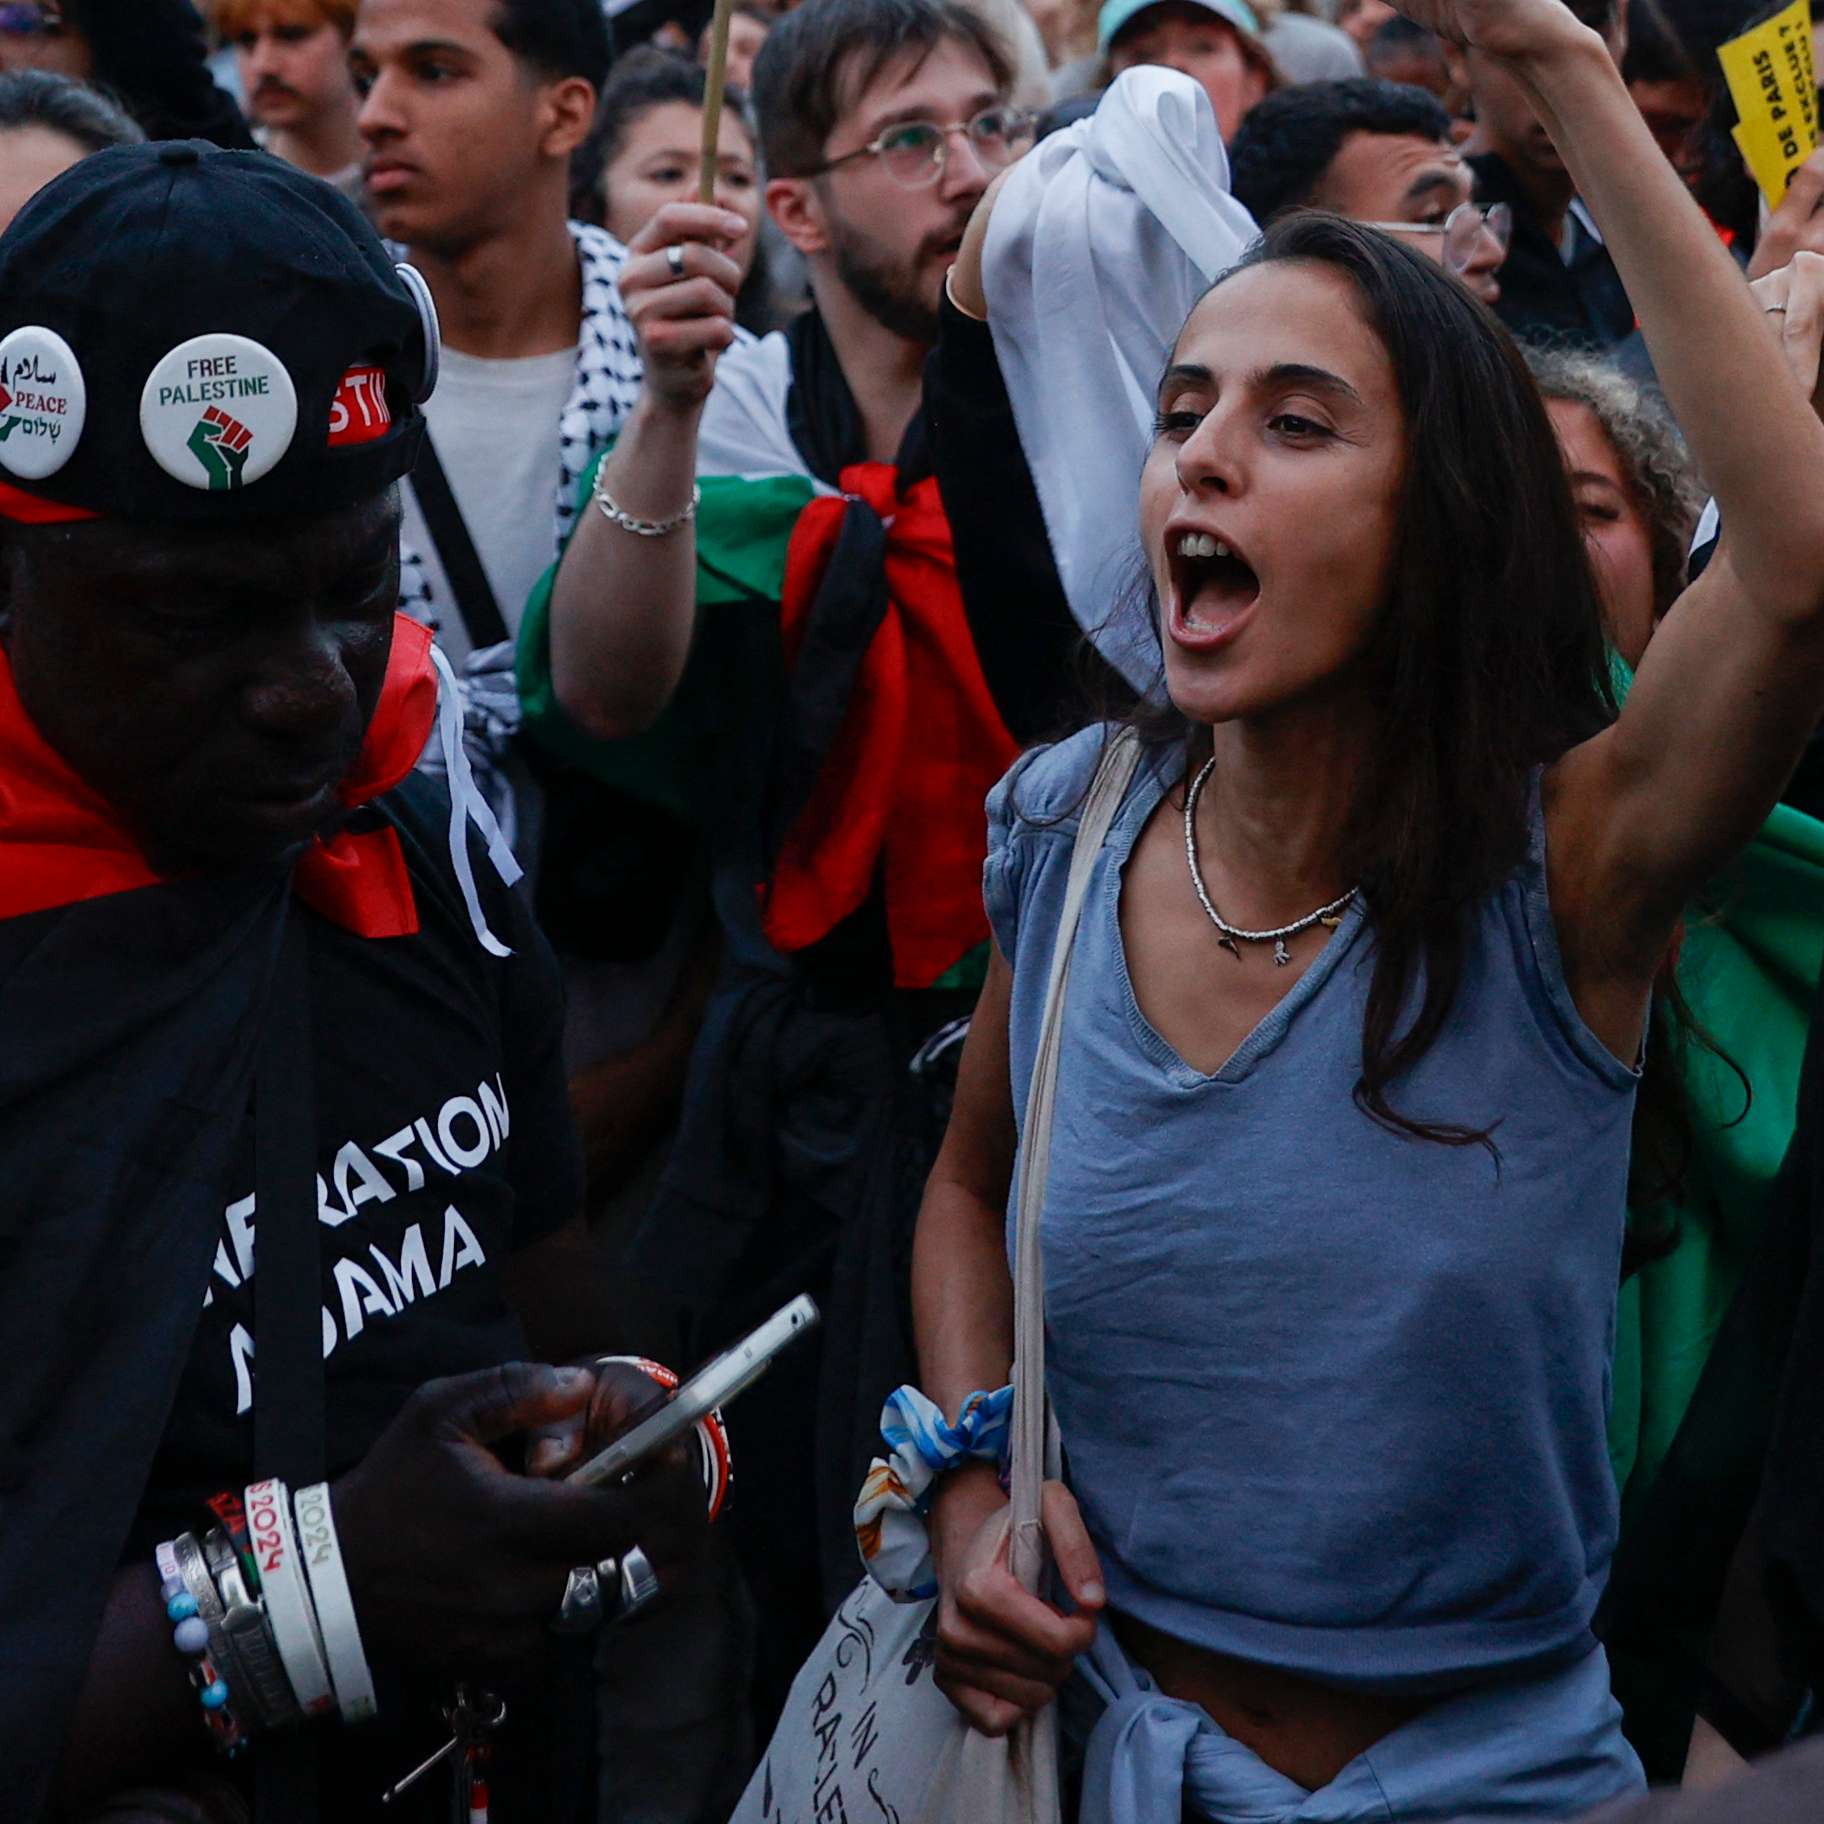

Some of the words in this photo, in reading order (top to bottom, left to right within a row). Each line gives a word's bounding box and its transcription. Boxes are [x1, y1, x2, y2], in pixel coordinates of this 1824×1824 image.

[1752, 50, 1787, 121] PARIS
[1778, 124, 1799, 160] DE
[13, 354, 56, 393] سلام
[187, 355, 237, 380] FREE
[15, 391, 67, 415] PEACE
[159, 376, 270, 407] PALESTINE
[250, 1494, 284, 1572] 2024
[299, 1495, 332, 1566] 2024
